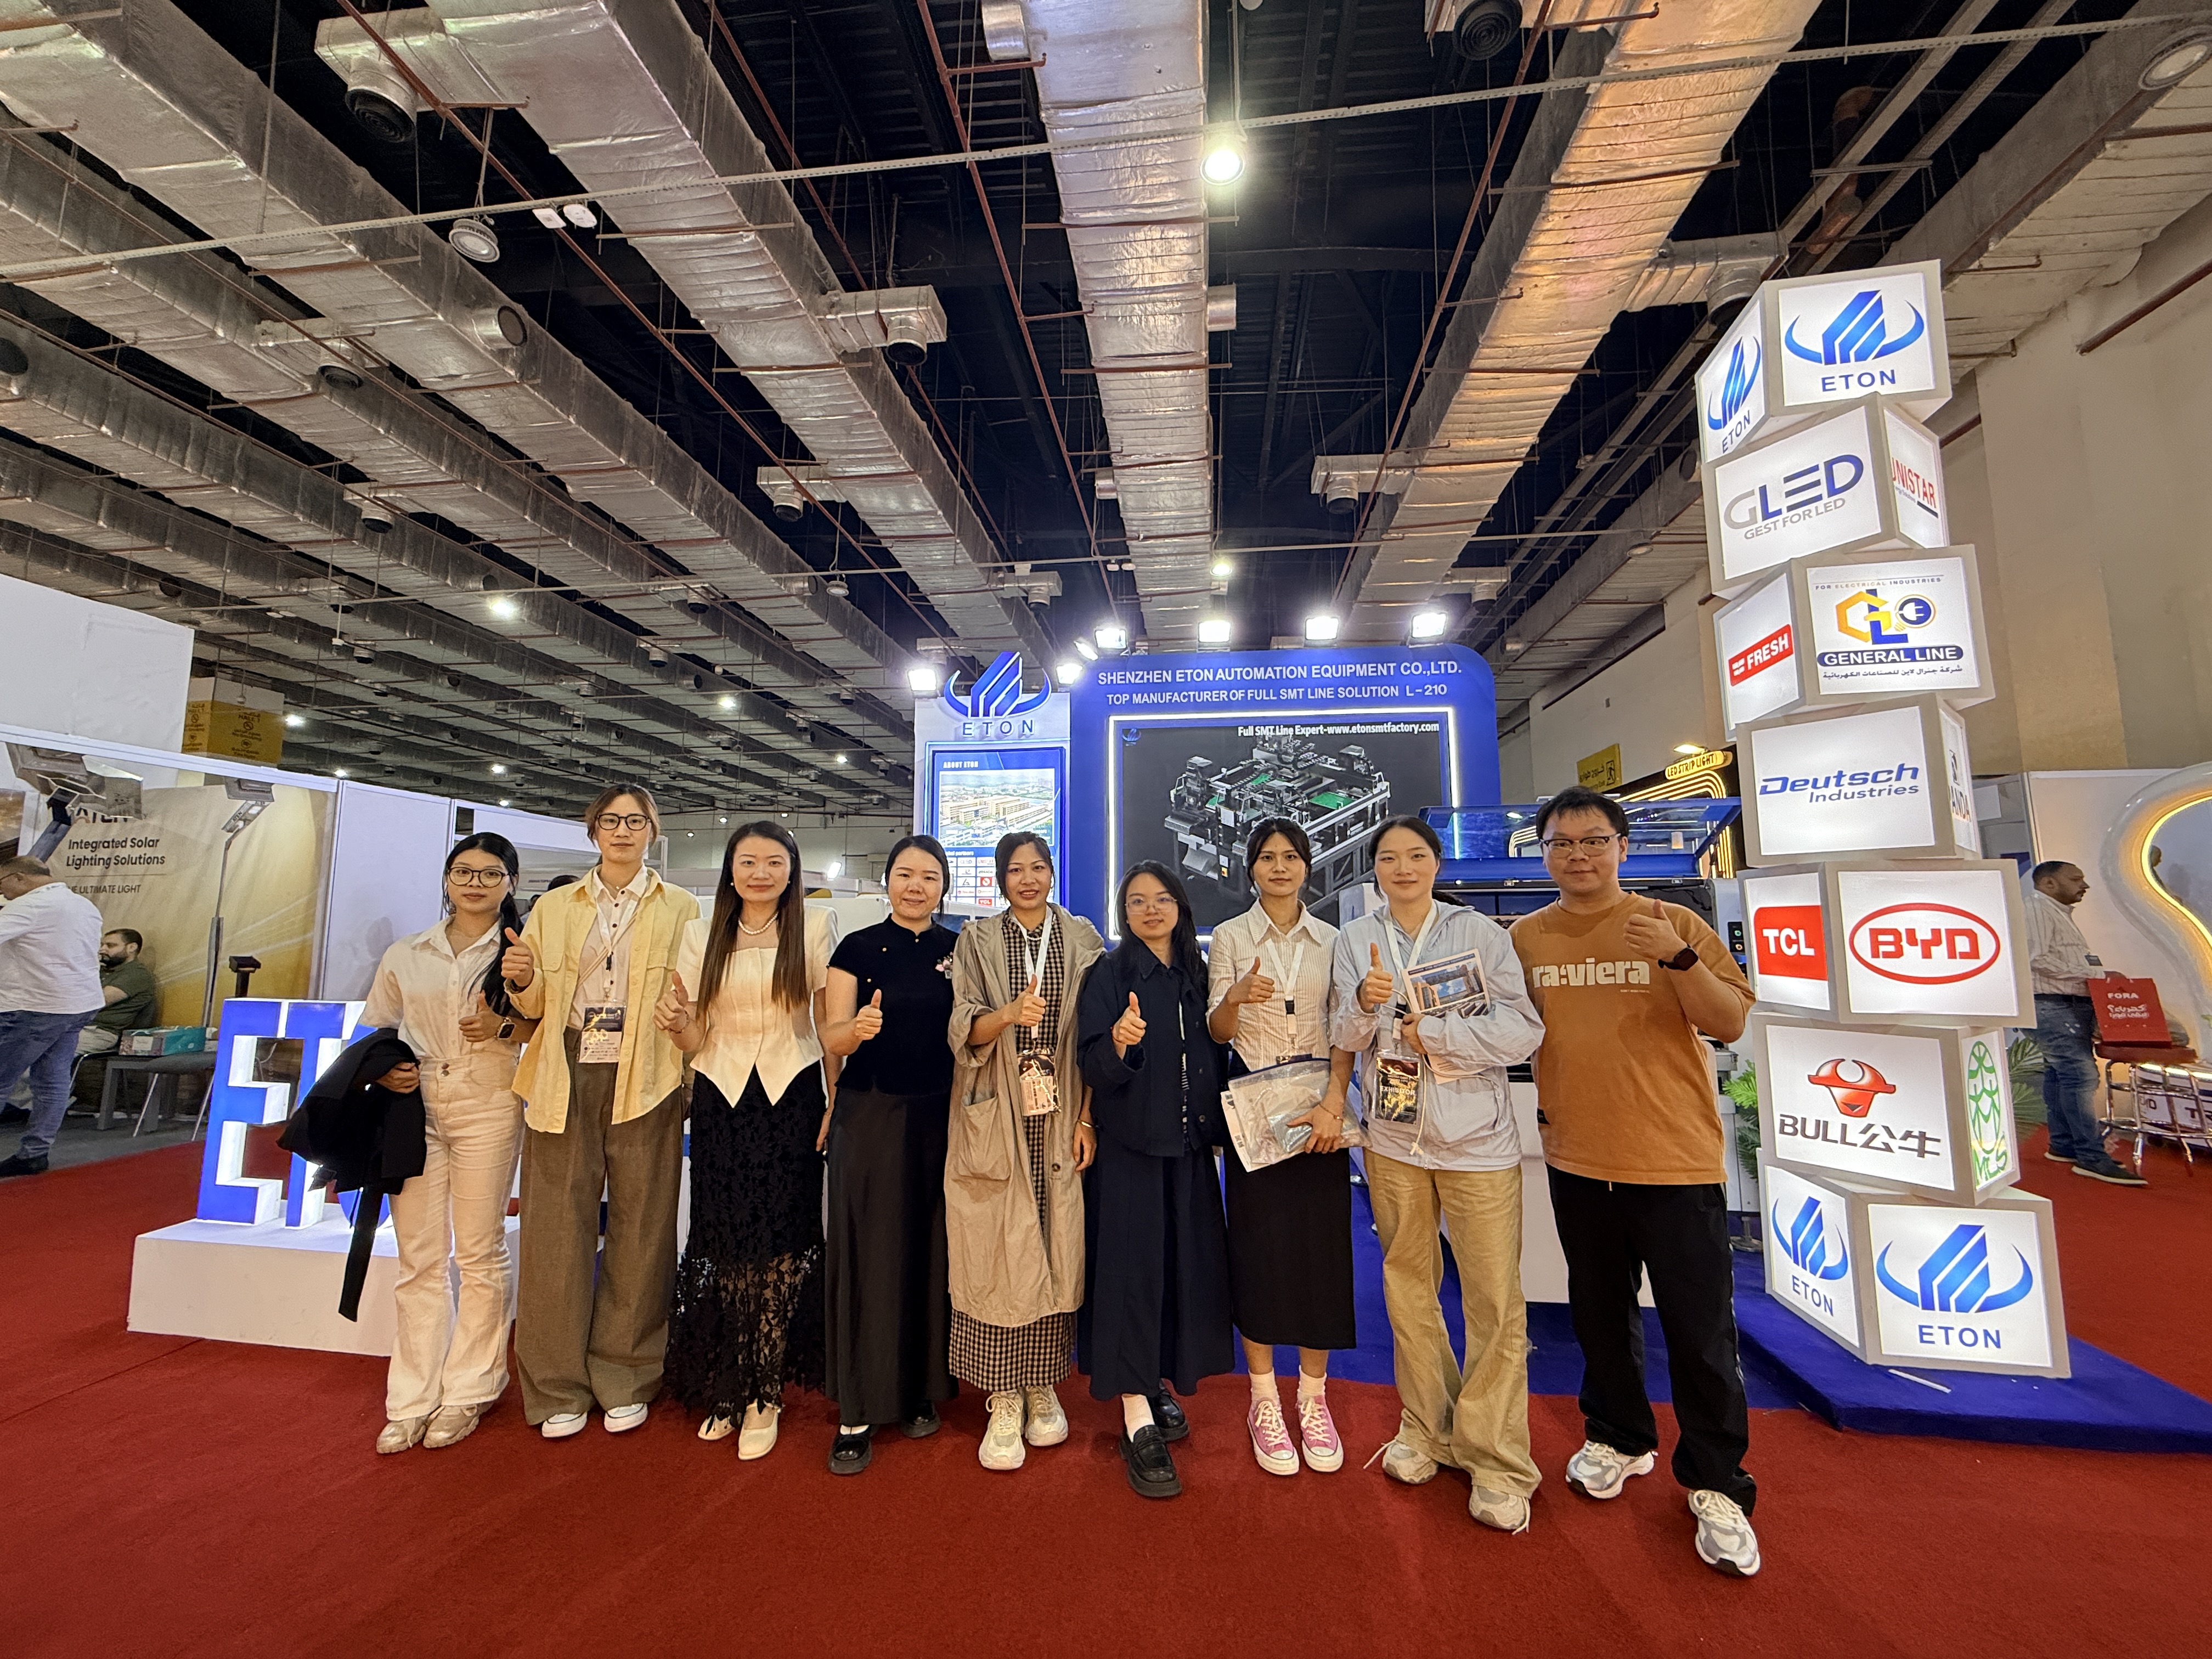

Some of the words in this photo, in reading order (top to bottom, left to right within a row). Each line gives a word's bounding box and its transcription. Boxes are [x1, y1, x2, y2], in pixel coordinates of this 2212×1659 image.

[1821, 370, 1896, 392] ETON
[1722, 411, 1751, 454] ETON
[1724, 454, 1864, 529] GLED
[1744, 520, 1779, 540] GEST
[1782, 509, 1812, 528] FOR
[1815, 498, 1846, 515] LED
[1747, 632, 1789, 670] FRESH
[1824, 650, 1911, 665] GENERAL
[1915, 647, 1957, 661] LINE
[1098, 670, 1172, 685] SHENZHEN
[1176, 668, 1214, 682] ETON
[1215, 665, 1307, 681] AUTOMATION
[1311, 663, 1397, 678] EQUIPMENT
[1400, 661, 1462, 676] CO.,LTD.
[1939, 665, 1963, 674] شركة
[1107, 693, 1130, 705] TOP
[1132, 690, 1228, 704] MANUFACTURER
[1229, 690, 1245, 701] OF
[1247, 689, 1277, 701] FULL
[1279, 688, 1305, 700] SMT
[1307, 687, 1334, 699] LINE
[1338, 686, 1399, 698] SOLUTION
[962, 719, 1034, 737] ETON
[1238, 725, 1254, 737] Full
[1255, 725, 1275, 736] SMT
[1276, 725, 1294, 736] Line
[1667, 766, 1678, 777] LED
[1679, 759, 1695, 774] STRIP
[1696, 753, 1714, 768] LIGHT
[1759, 763, 1919, 795] Deutsch
[1810, 783, 1919, 803] Industries
[1948, 786, 1972, 822] ANDA
[68, 837, 128, 853] Integrated
[129, 837, 160, 848] Solar
[66, 854, 112, 870] Lighting
[114, 853, 166, 866] Solutions
[80, 885, 116, 894] ULTIMATE
[117, 884, 141, 893] LIGHT
[1763, 928, 1815, 956] TCL
[1869, 928, 1980, 960] BYD
[1779, 1113, 1858, 1148] BULL
[1858, 1123, 1941, 1158] 公牛
[1792, 1274, 1833, 1317] ETON
[1917, 1324, 2001, 1349] ETON
